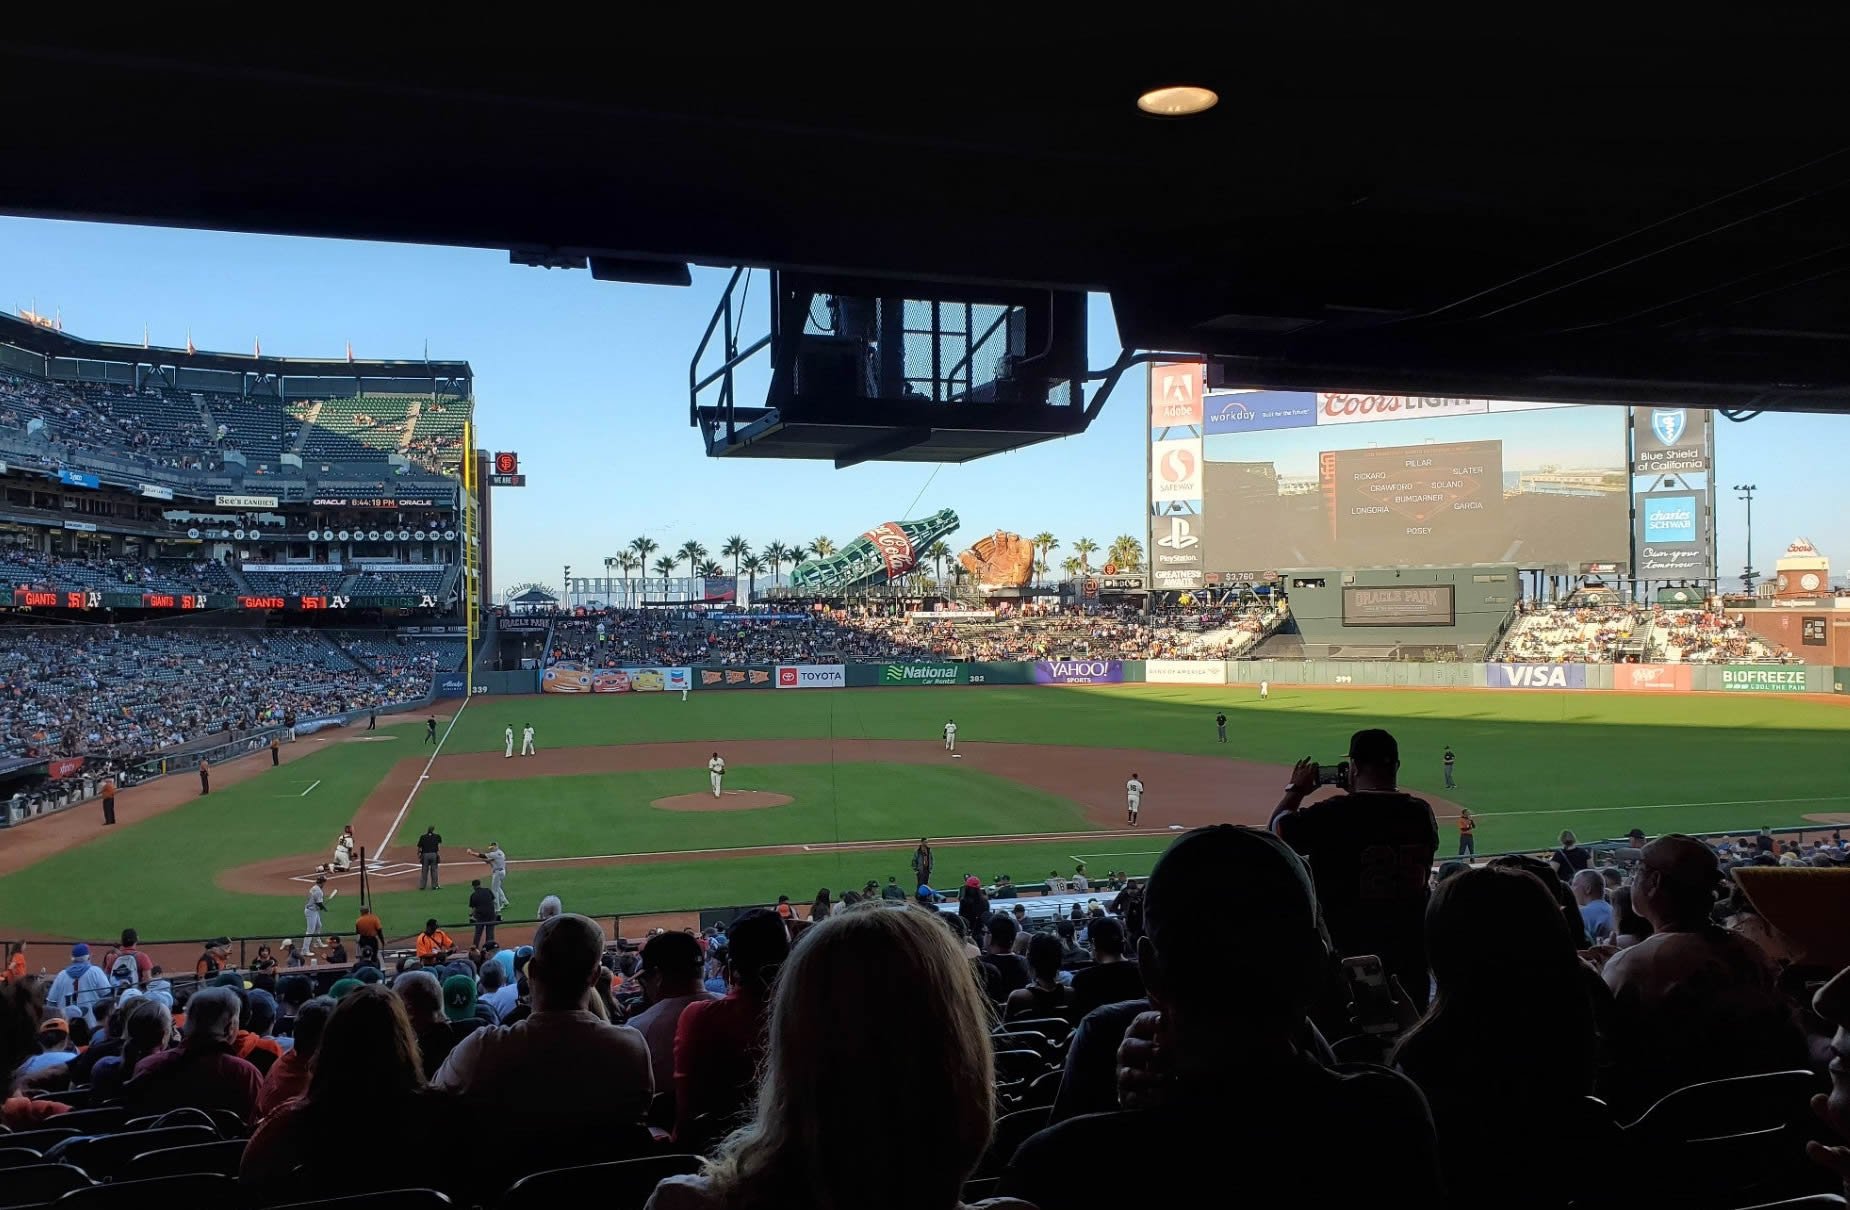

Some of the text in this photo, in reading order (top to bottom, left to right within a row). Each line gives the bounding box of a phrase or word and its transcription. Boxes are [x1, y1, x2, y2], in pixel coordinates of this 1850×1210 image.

[1325, 393, 1400, 416] Coors
[1163, 404, 1193, 416] Adobe
[1210, 410, 1255, 422] workday
[1641, 449, 1699, 461] Blue Shield
[1405, 459, 1432, 468] PILLAR
[1638, 460, 1703, 471] of California
[1452, 466, 1484, 475] SLATER
[1354, 471, 1386, 481] RICKARD
[1160, 482, 1193, 492] SAFEWAY
[1370, 483, 1412, 492] CRAWFORD
[1431, 480, 1464, 489] SOLANO
[1395, 494, 1443, 503] BUMGARNER
[1351, 505, 1390, 515] LONGORIA
[1454, 501, 1484, 510] GARCIA
[1651, 509, 1690, 520] charles
[1651, 520, 1690, 529] SCHWAB
[1406, 527, 1432, 535] POSEY
[1160, 555, 1198, 563] PlayStation
[1671, 549, 1700, 562] your
[1642, 559, 1703, 569] tomorrow
[1155, 570, 1202, 579] GREATNESS
[25, 593, 57, 606] GIANTS
[150, 595, 174, 607] GIANTS
[245, 597, 285, 608] GIANTS
[1355, 590, 1438, 607] ORACLE PARK
[500, 619, 529, 630] ORACLE
[904, 666, 958, 679] National
[1051, 663, 1109, 678] YAHOO!
[801, 672, 842, 681] TOYOTA
[1501, 666, 1567, 687] VISA
[1723, 671, 1805, 683] BIOFREEZE
[471, 686, 488, 694] 339
